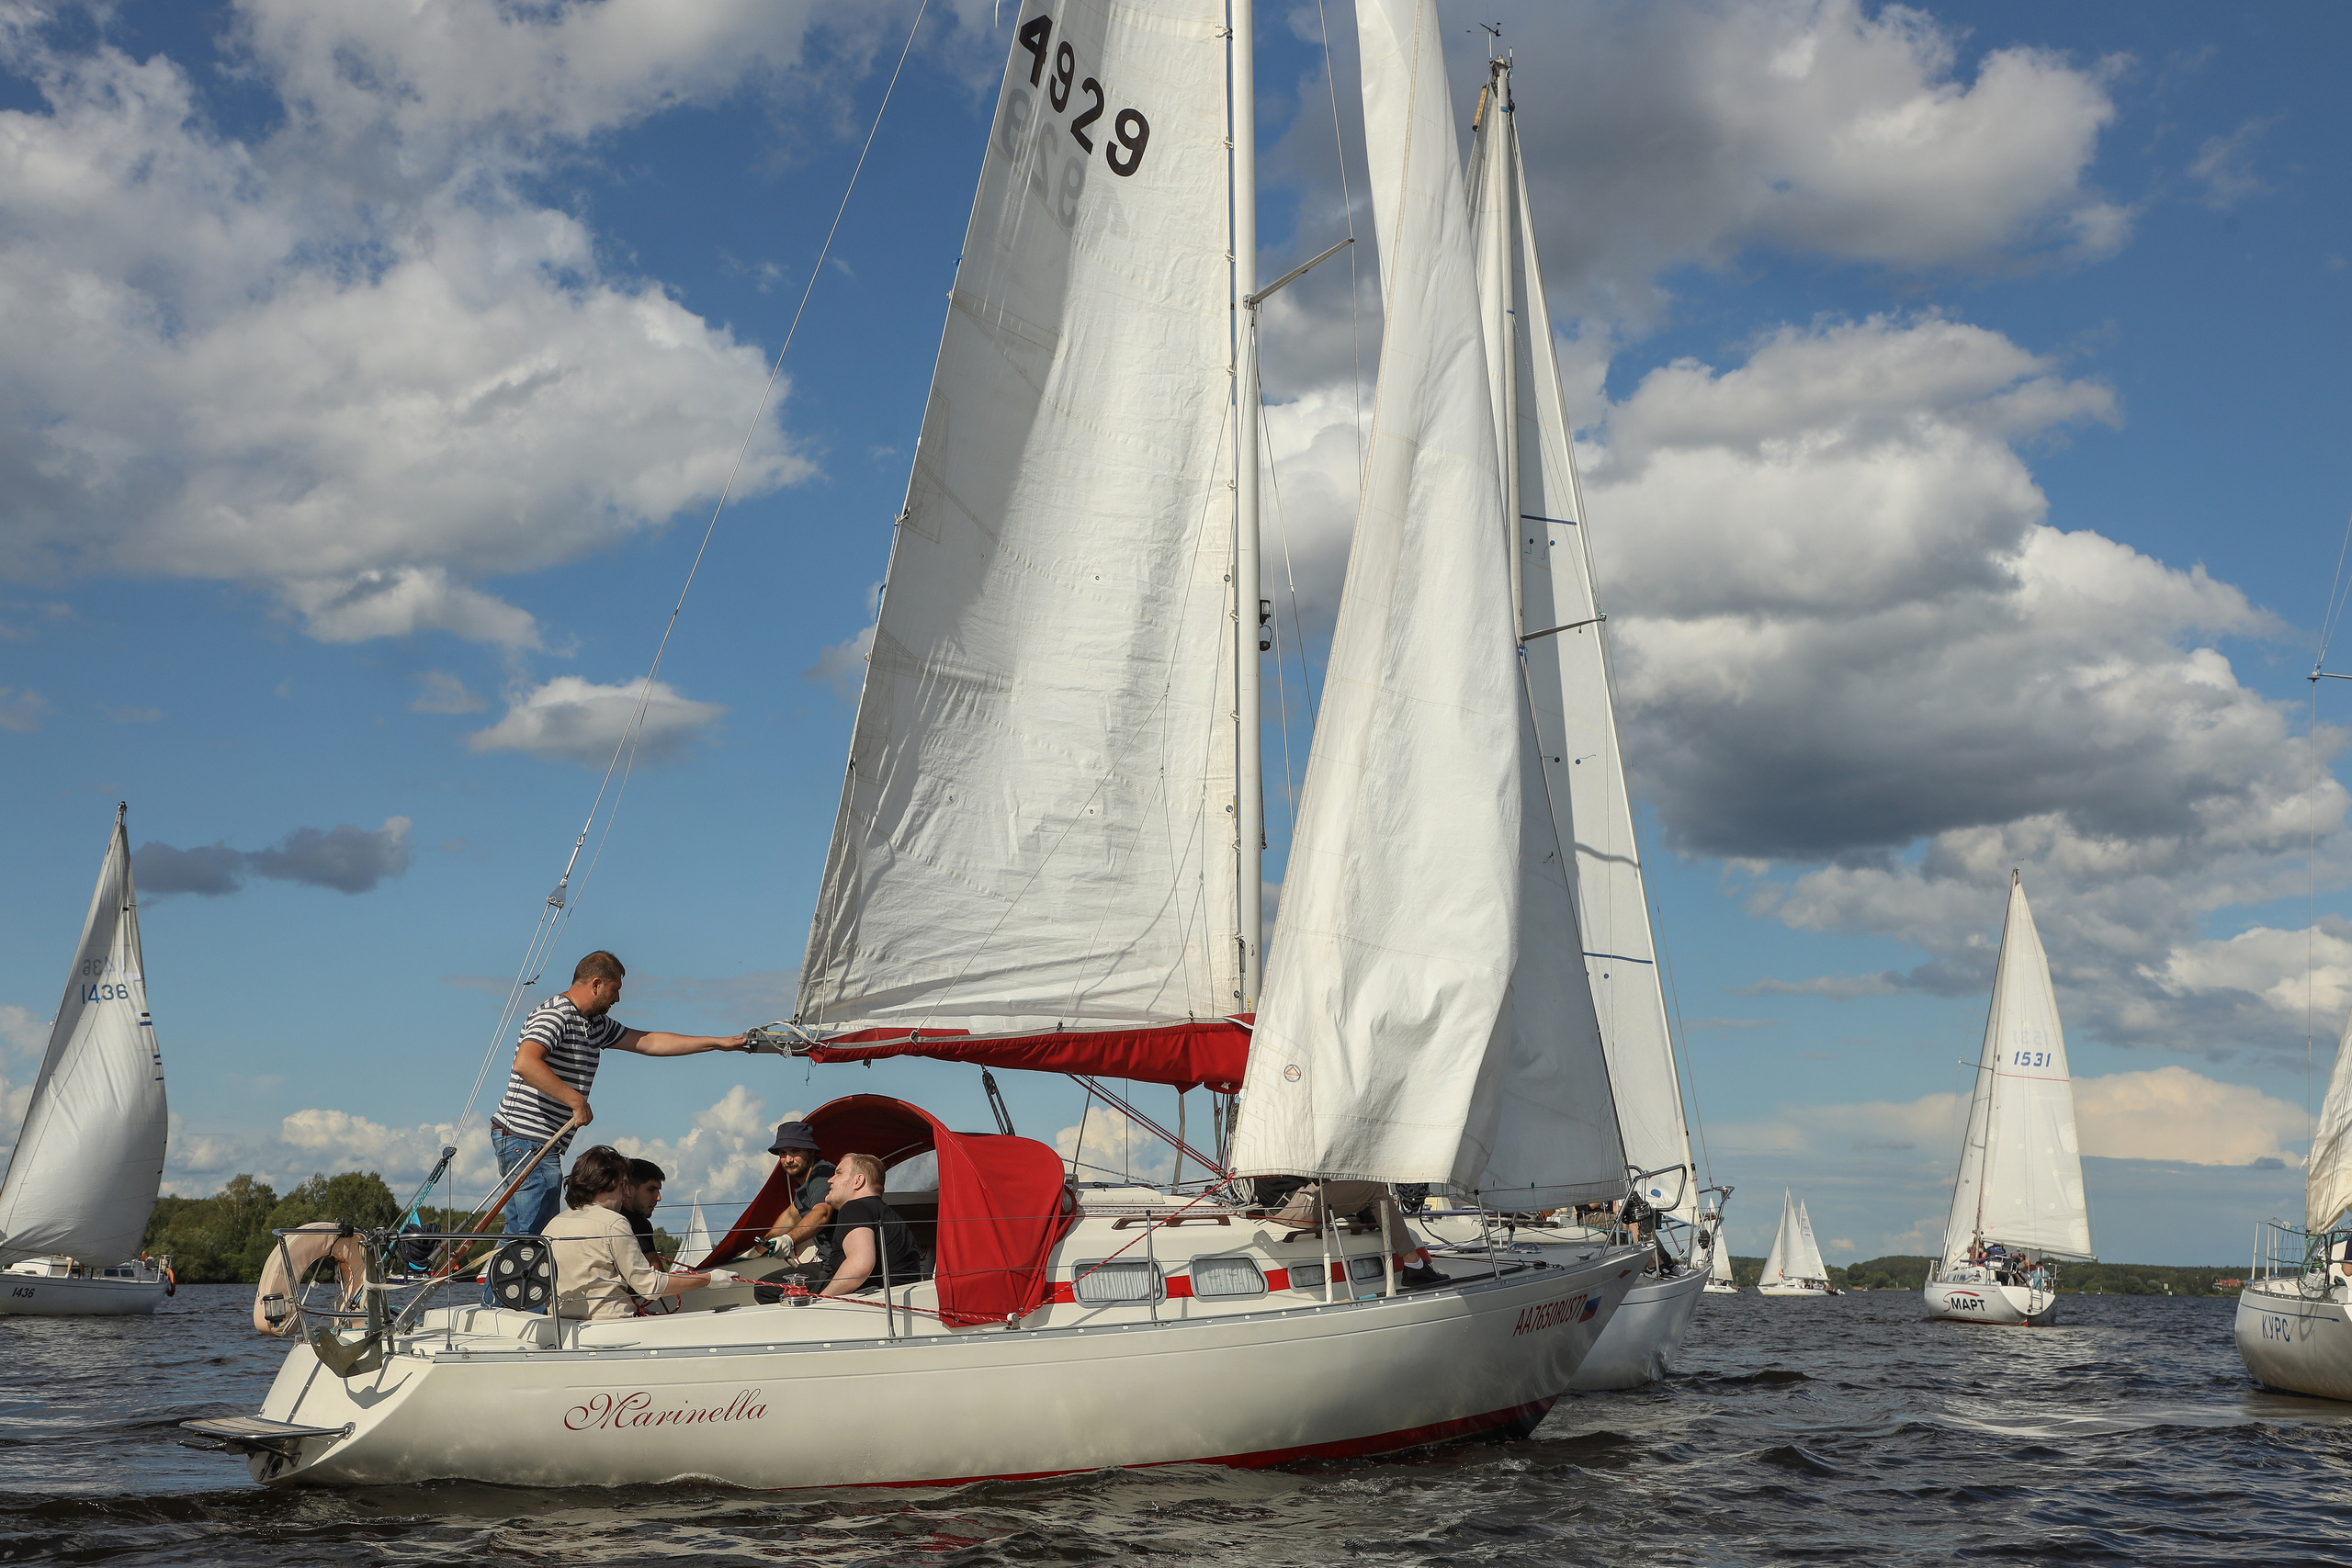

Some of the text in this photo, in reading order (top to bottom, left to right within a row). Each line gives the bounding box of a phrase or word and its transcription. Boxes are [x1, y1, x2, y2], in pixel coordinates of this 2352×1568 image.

[1019, 15, 1150, 177] 4929
[81, 983, 129, 1005] 1436
[2013, 1051, 2052, 1067] 1531
[11, 1287, 36, 1298] 1436
[1512, 1293, 1589, 1337] AA7650RUS77
[2262, 1314, 2290, 1343] КУРС
[563, 1388, 769, 1430] Marinella
